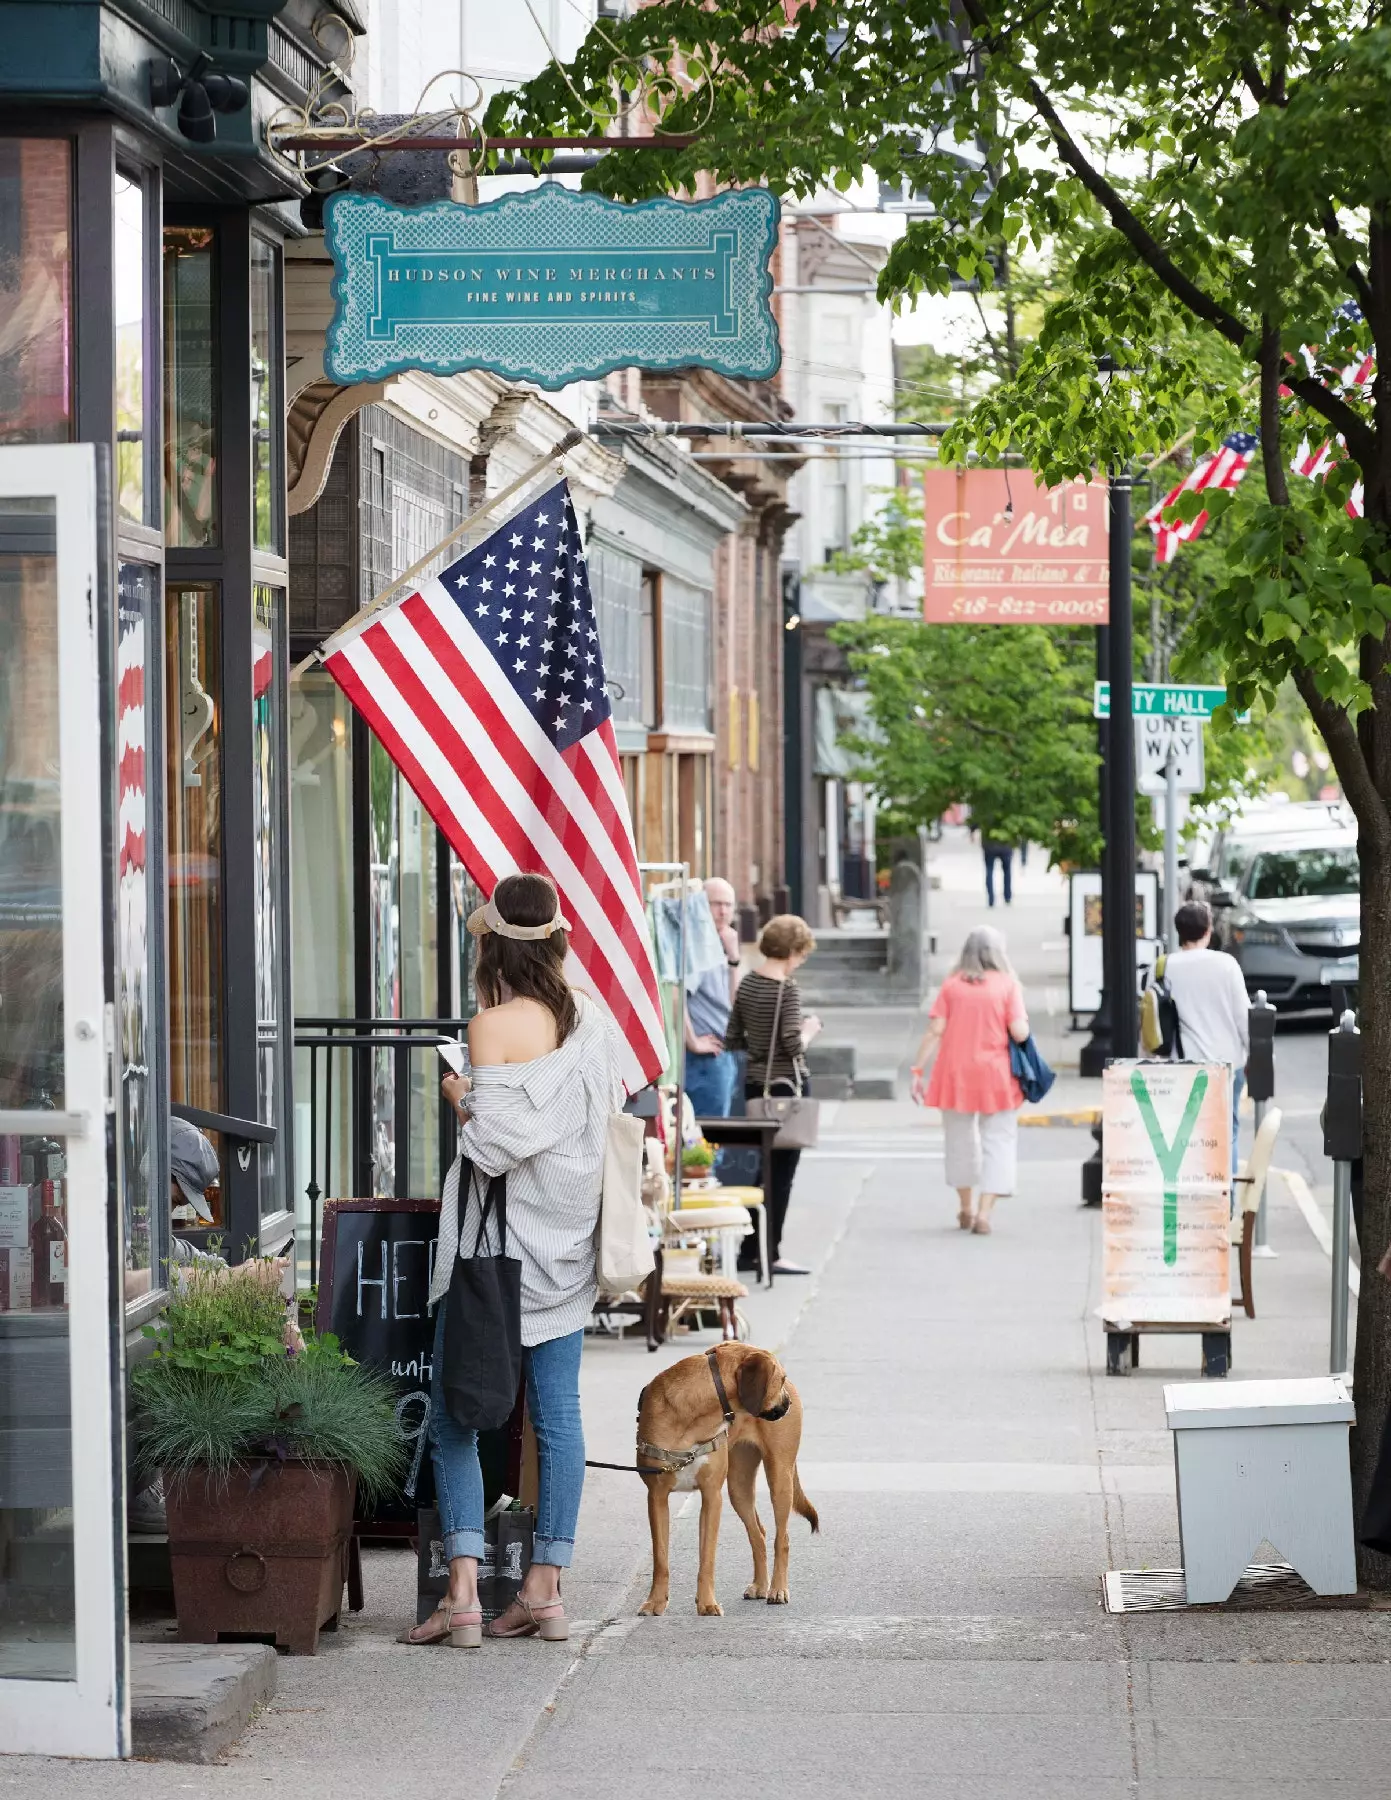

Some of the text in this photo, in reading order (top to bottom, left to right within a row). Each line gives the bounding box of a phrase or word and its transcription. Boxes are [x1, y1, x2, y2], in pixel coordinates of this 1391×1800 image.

[387, 267, 717, 282] HUDSON WINE MERCHANTS
[467, 291, 637, 303] FINE WINE AND SPIRITS
[948, 595, 1109, 618] 518-822-0005
[1133, 690, 1209, 714] TY HALL
[1146, 737, 1194, 757] WAY
